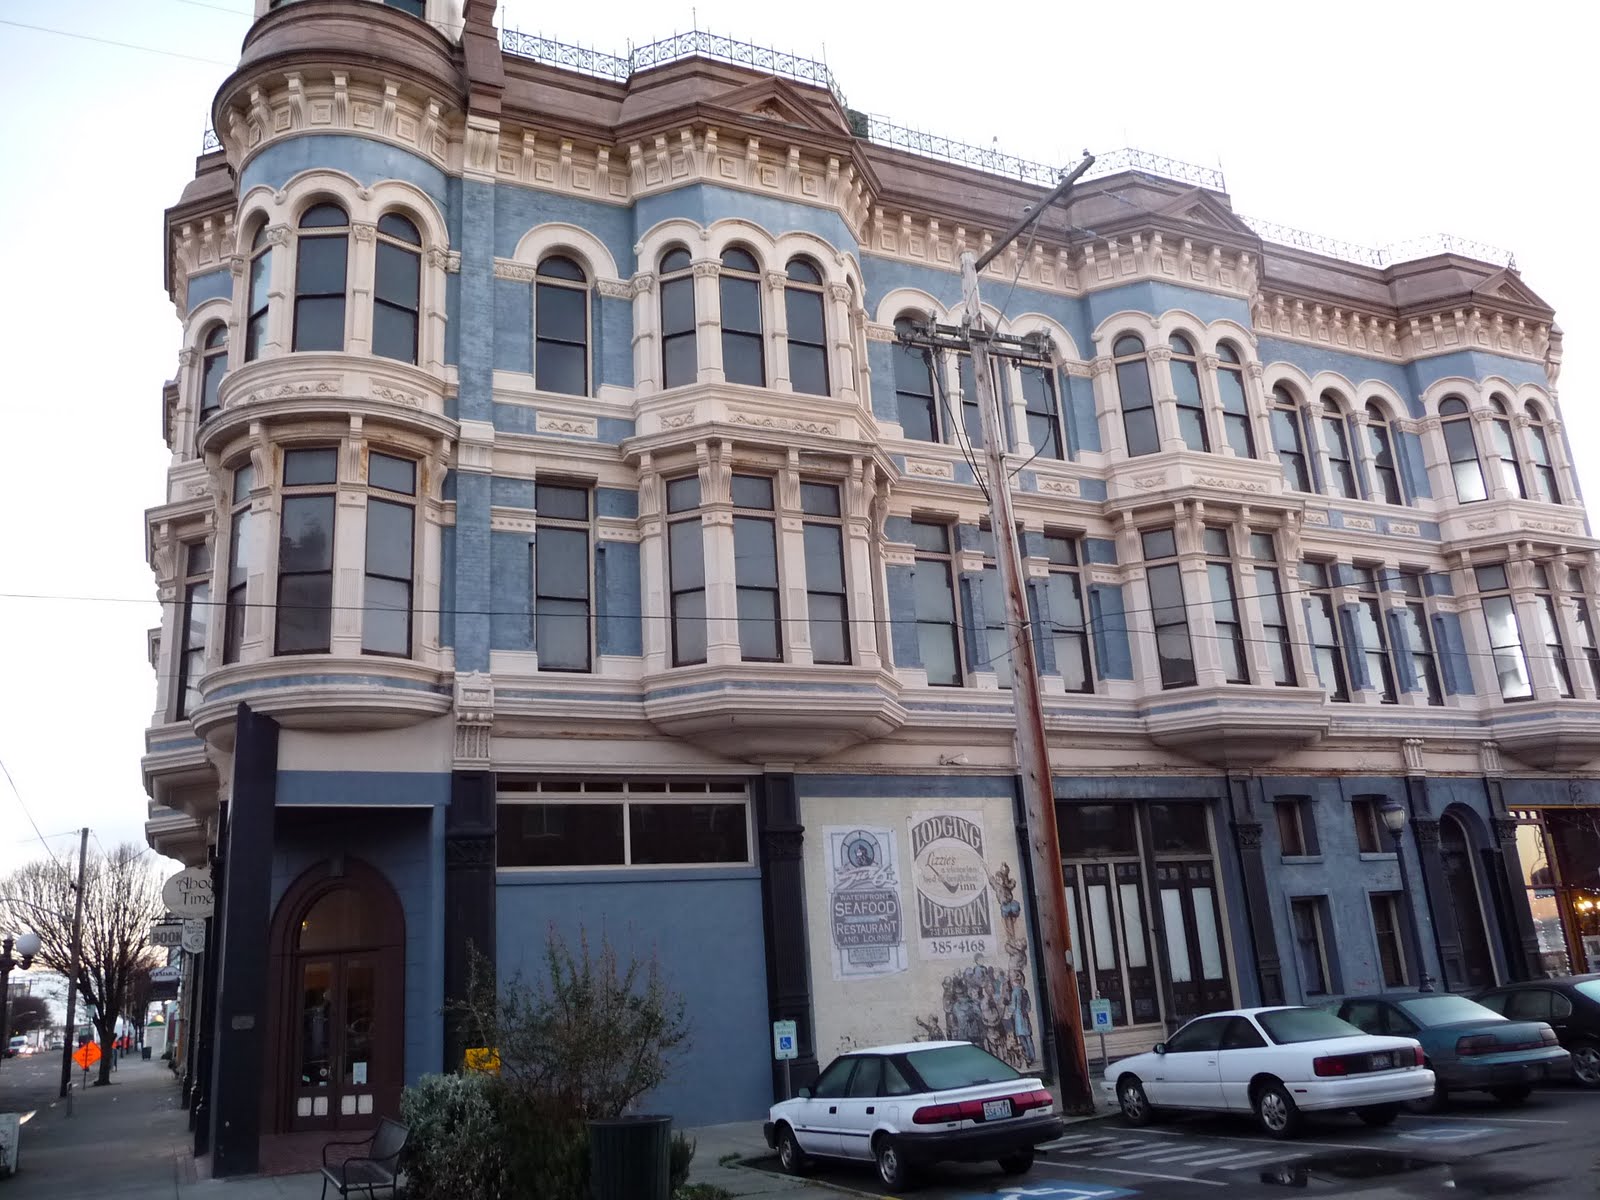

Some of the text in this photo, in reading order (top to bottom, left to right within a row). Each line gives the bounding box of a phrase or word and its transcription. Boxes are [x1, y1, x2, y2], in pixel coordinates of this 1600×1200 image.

[914, 816, 981, 855] LODGING
[925, 851, 956, 866] Lizzie's
[181, 891, 214, 905] Time
[839, 893, 890, 901] WATERFRONT
[835, 900, 896, 917] SEAFOOD
[920, 890, 988, 928] UPTOWN
[836, 920, 897, 935] RESTAURANT
[942, 927, 970, 936] PIERCE
[931, 939, 986, 954] 385-4168
